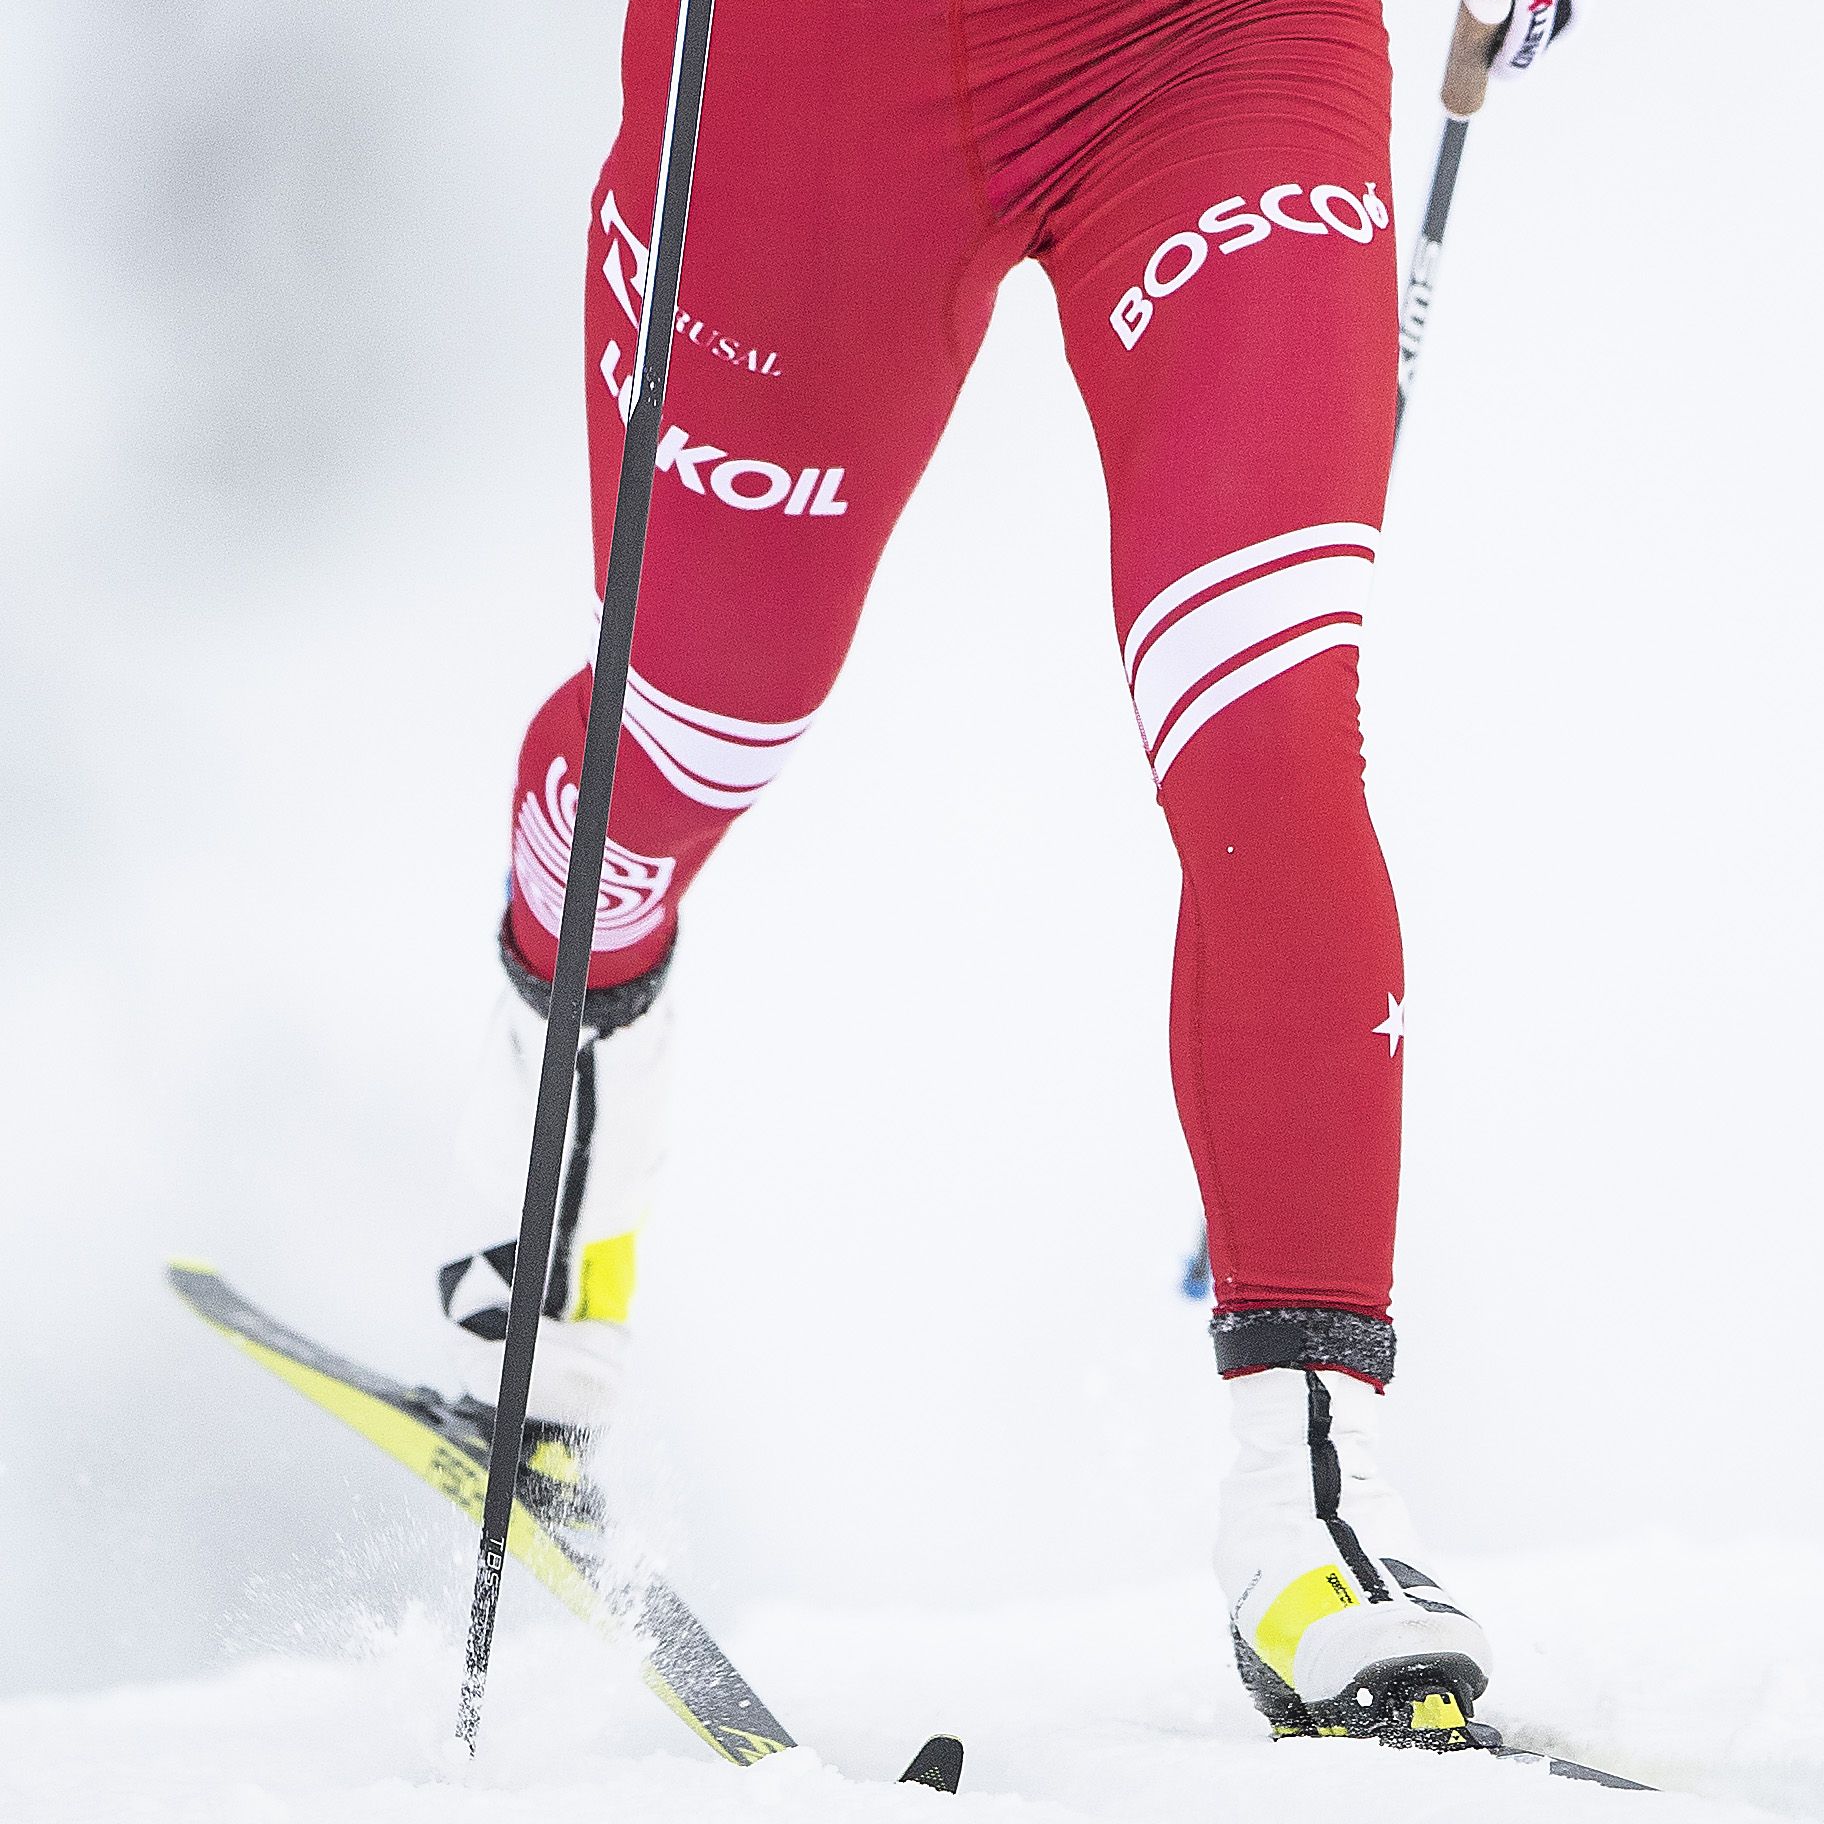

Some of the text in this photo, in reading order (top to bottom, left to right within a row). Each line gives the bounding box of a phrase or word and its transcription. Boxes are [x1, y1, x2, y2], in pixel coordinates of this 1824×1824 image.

[675, 305, 783, 377] RUSAL
[1109, 183, 1374, 351] BOSCO
[600, 339, 849, 517] LKOIL
